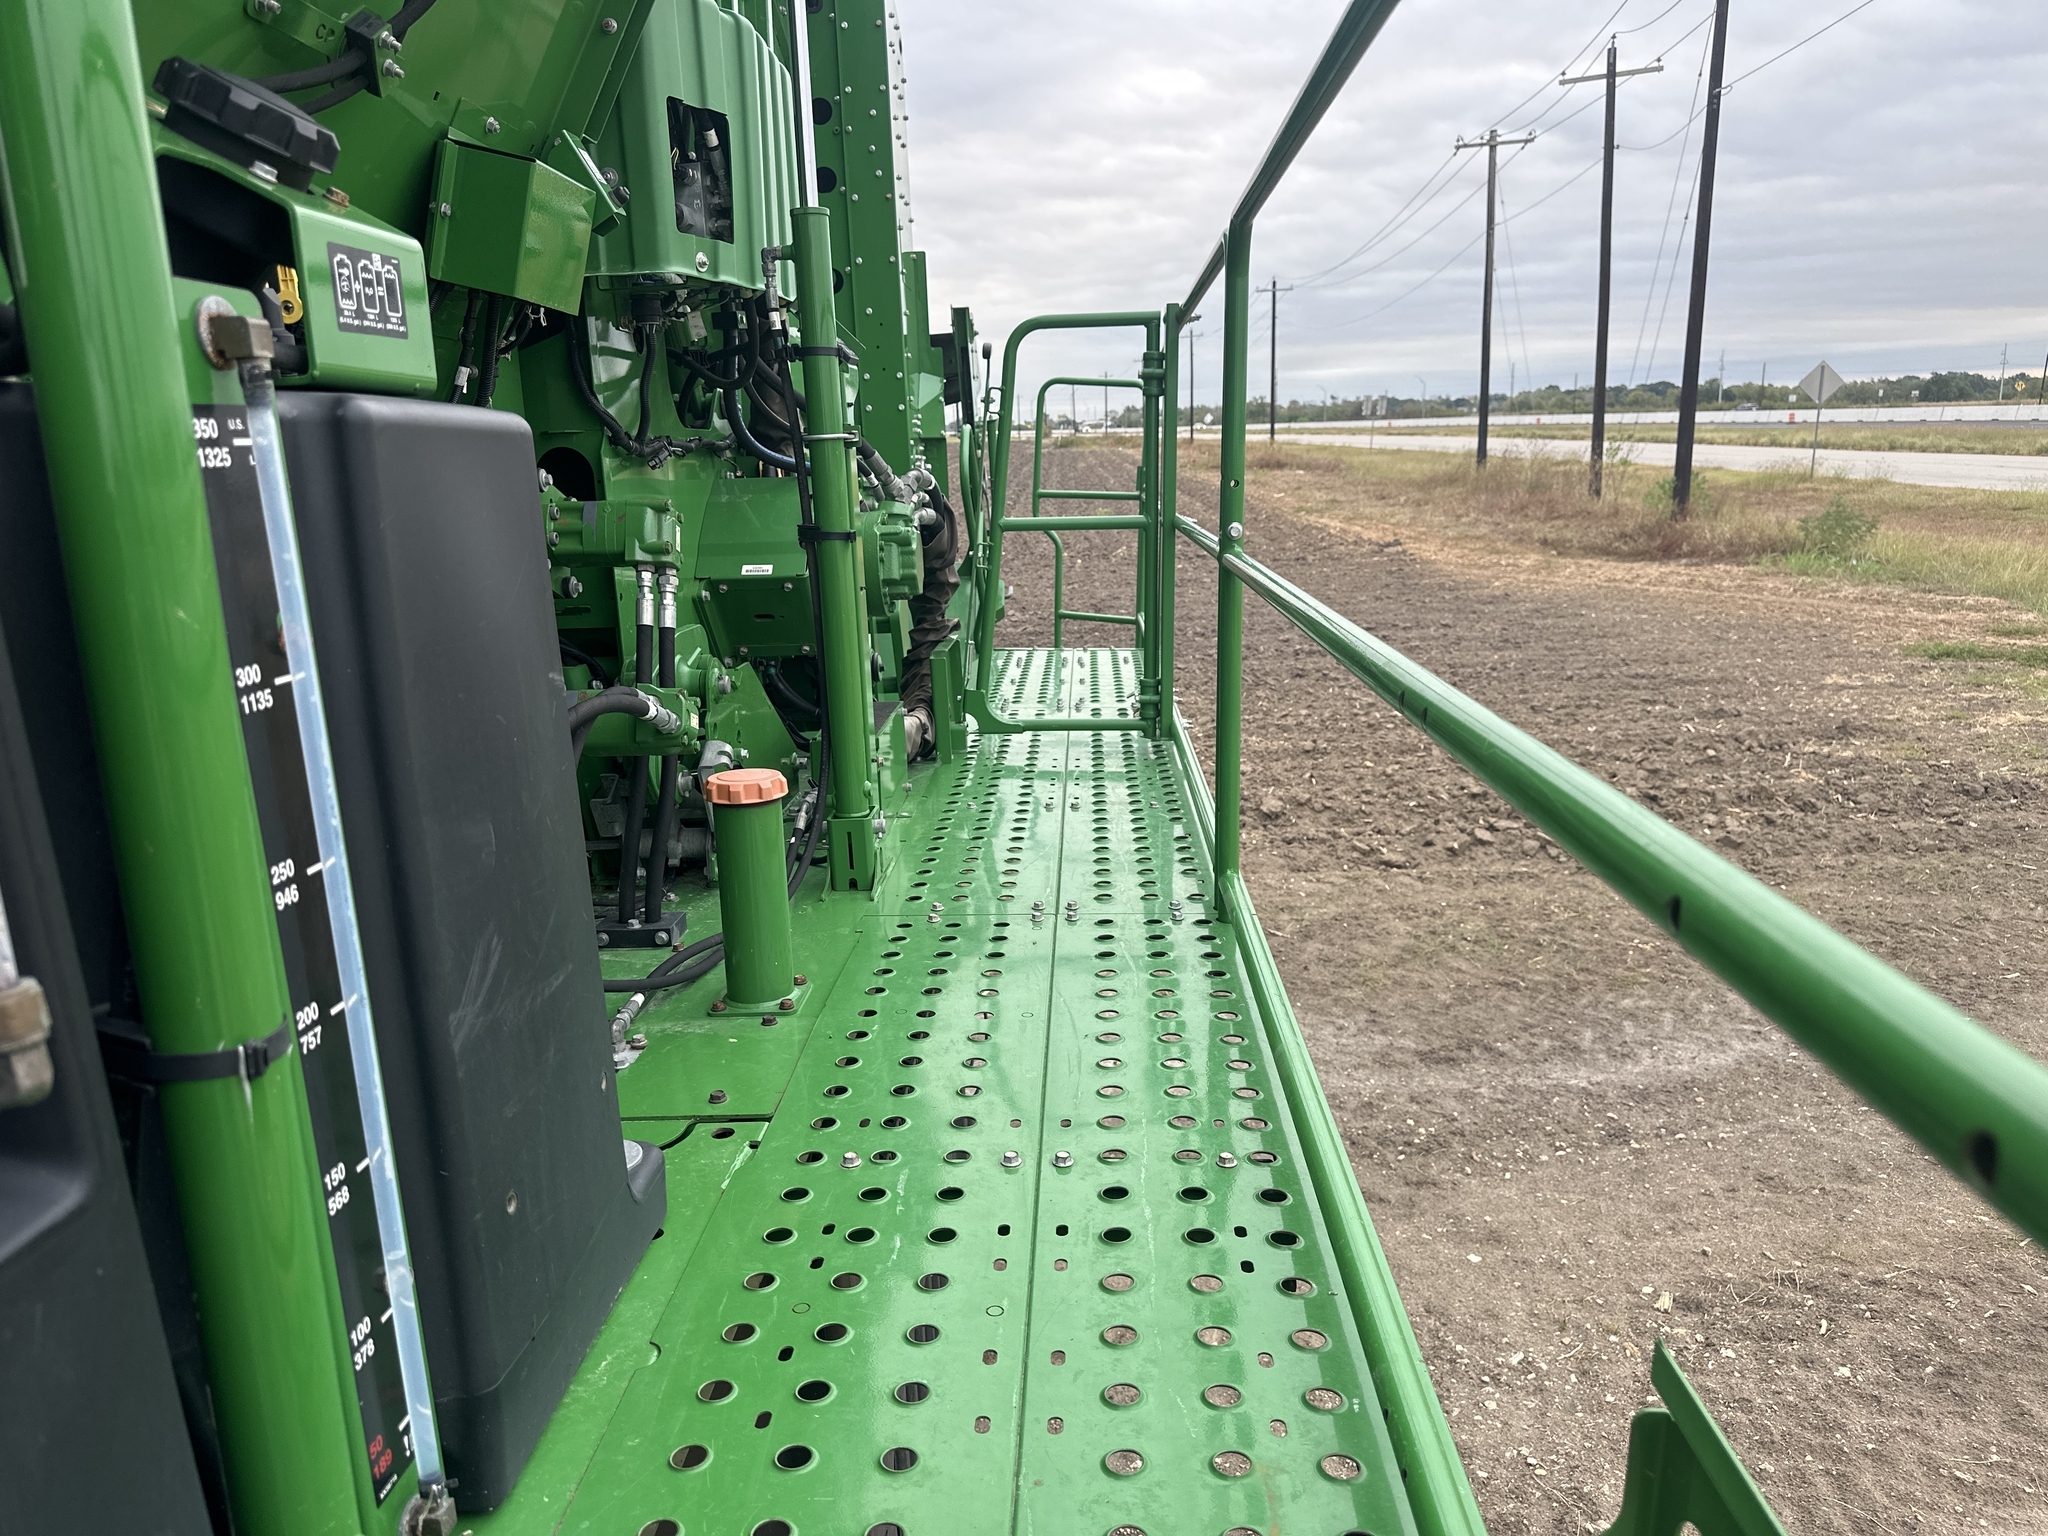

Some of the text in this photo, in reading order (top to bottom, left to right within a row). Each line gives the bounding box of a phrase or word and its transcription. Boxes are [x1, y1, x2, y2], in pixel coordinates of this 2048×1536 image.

[193, 417, 245, 439] 350 U.S.
[197, 447, 232, 469] 1325
[235, 663, 262, 688] 300
[241, 687, 274, 715] 1135
[270, 857, 295, 886] 250
[275, 883, 300, 911] 946
[296, 1001, 319, 1031] 200
[300, 1024, 322, 1055] 757
[324, 1161, 346, 1191] 150
[327, 1185, 350, 1216] 568
[350, 1315, 371, 1347] 100
[354, 1338, 375, 1371] 378
[369, 1434, 384, 1459] 50
[374, 1448, 393, 1479] 189
